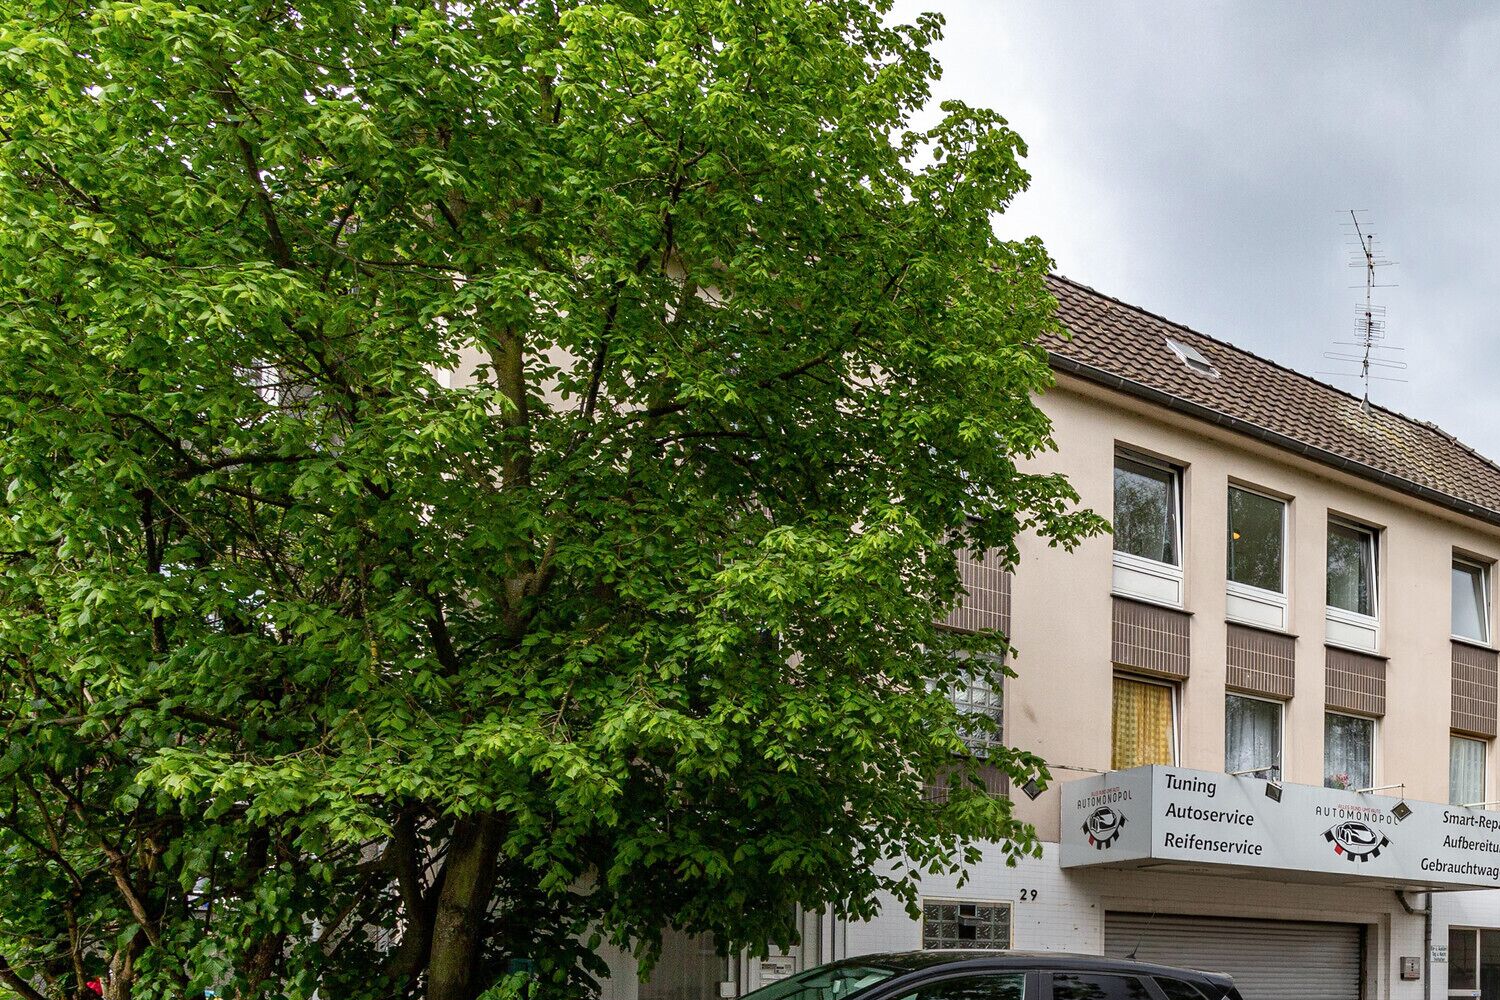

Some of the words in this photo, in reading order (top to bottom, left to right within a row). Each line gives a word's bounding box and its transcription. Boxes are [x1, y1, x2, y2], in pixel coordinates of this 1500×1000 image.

[1165, 773, 1217, 798] Tuning
[1077, 790, 1132, 810] AUTOMONOPOL
[1165, 802, 1255, 826] Autoservice
[1164, 832, 1263, 856] Reifenservice
[1020, 888, 1038, 901] 29
